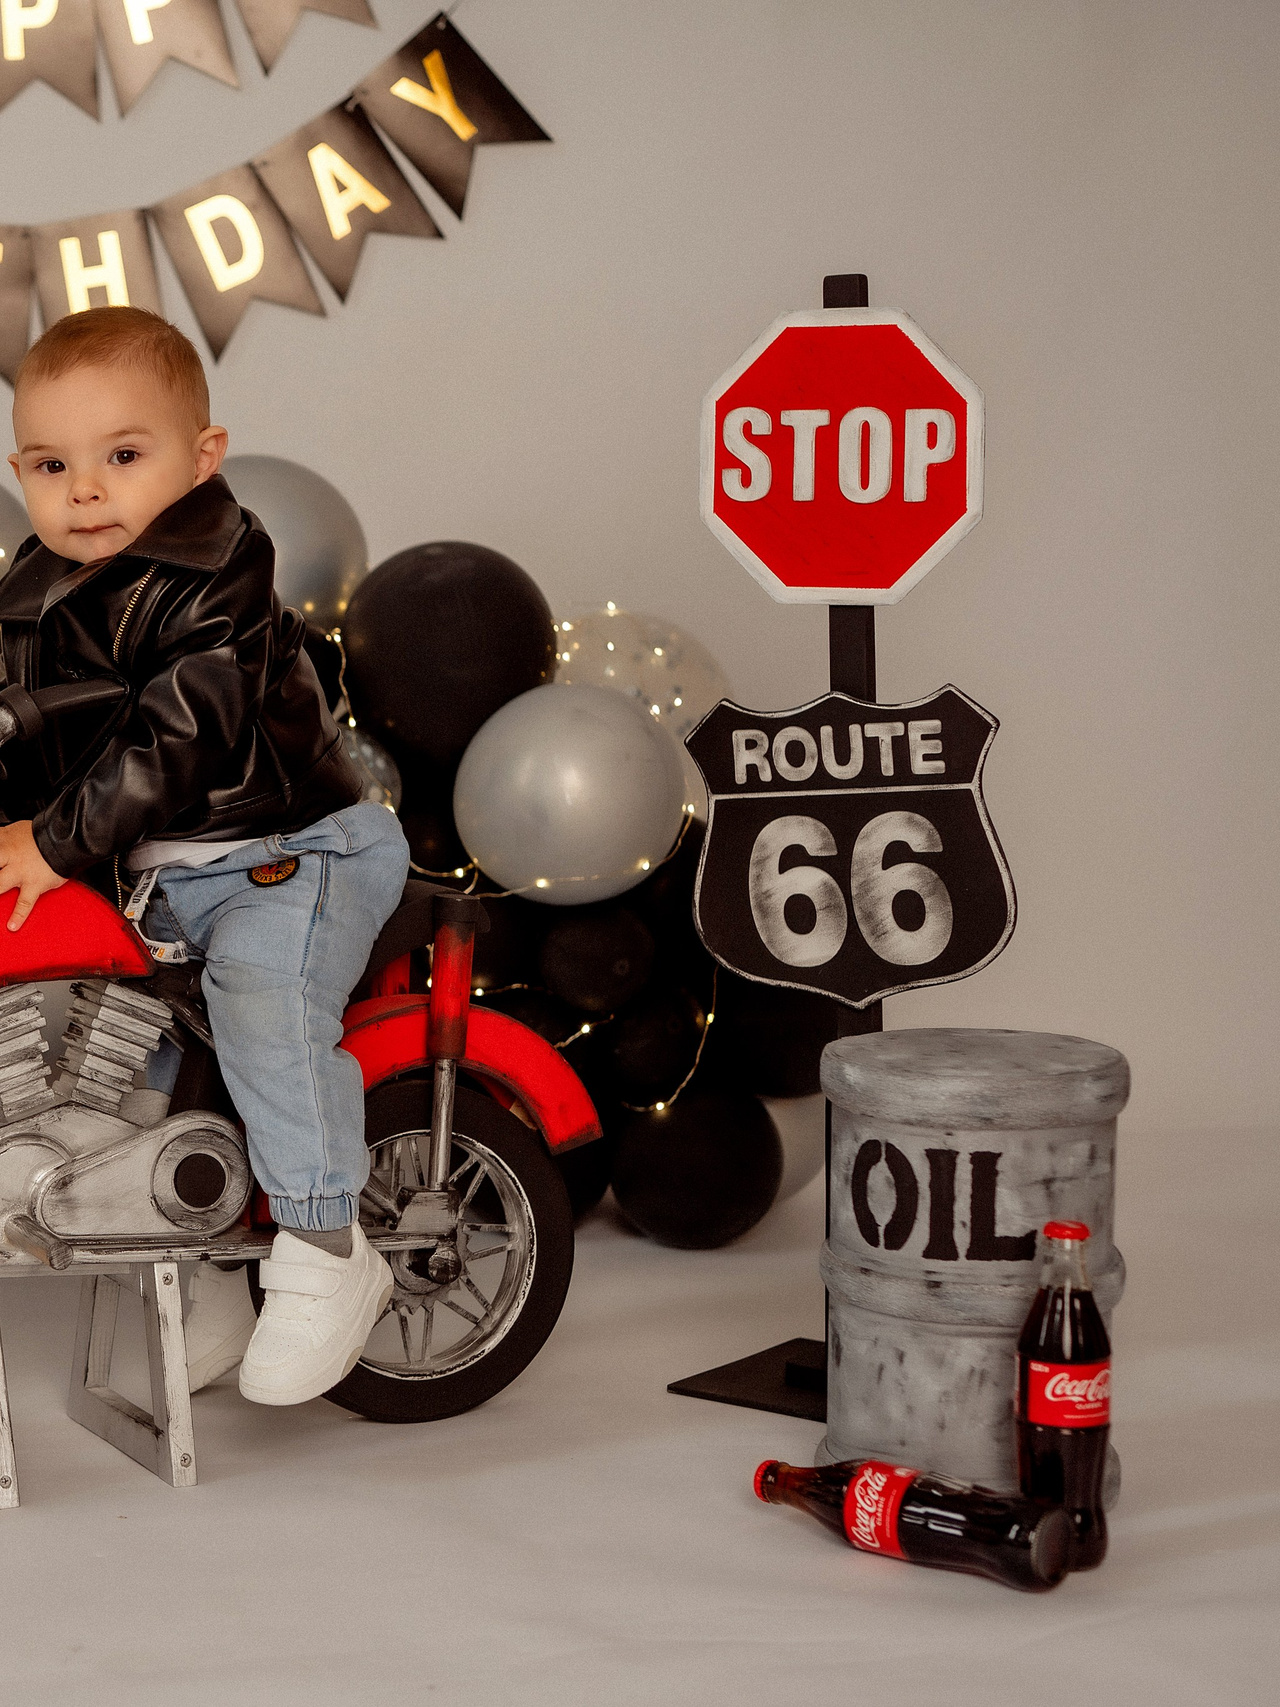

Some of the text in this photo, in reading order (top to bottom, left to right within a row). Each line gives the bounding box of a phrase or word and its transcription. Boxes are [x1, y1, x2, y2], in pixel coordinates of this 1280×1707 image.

[721, 406, 957, 504] STOP
[731, 718, 947, 785] ROUTE
[748, 810, 955, 968] 66
[851, 1139, 1038, 1261] OIL
[851, 1467, 889, 1548] Coca-Cola
